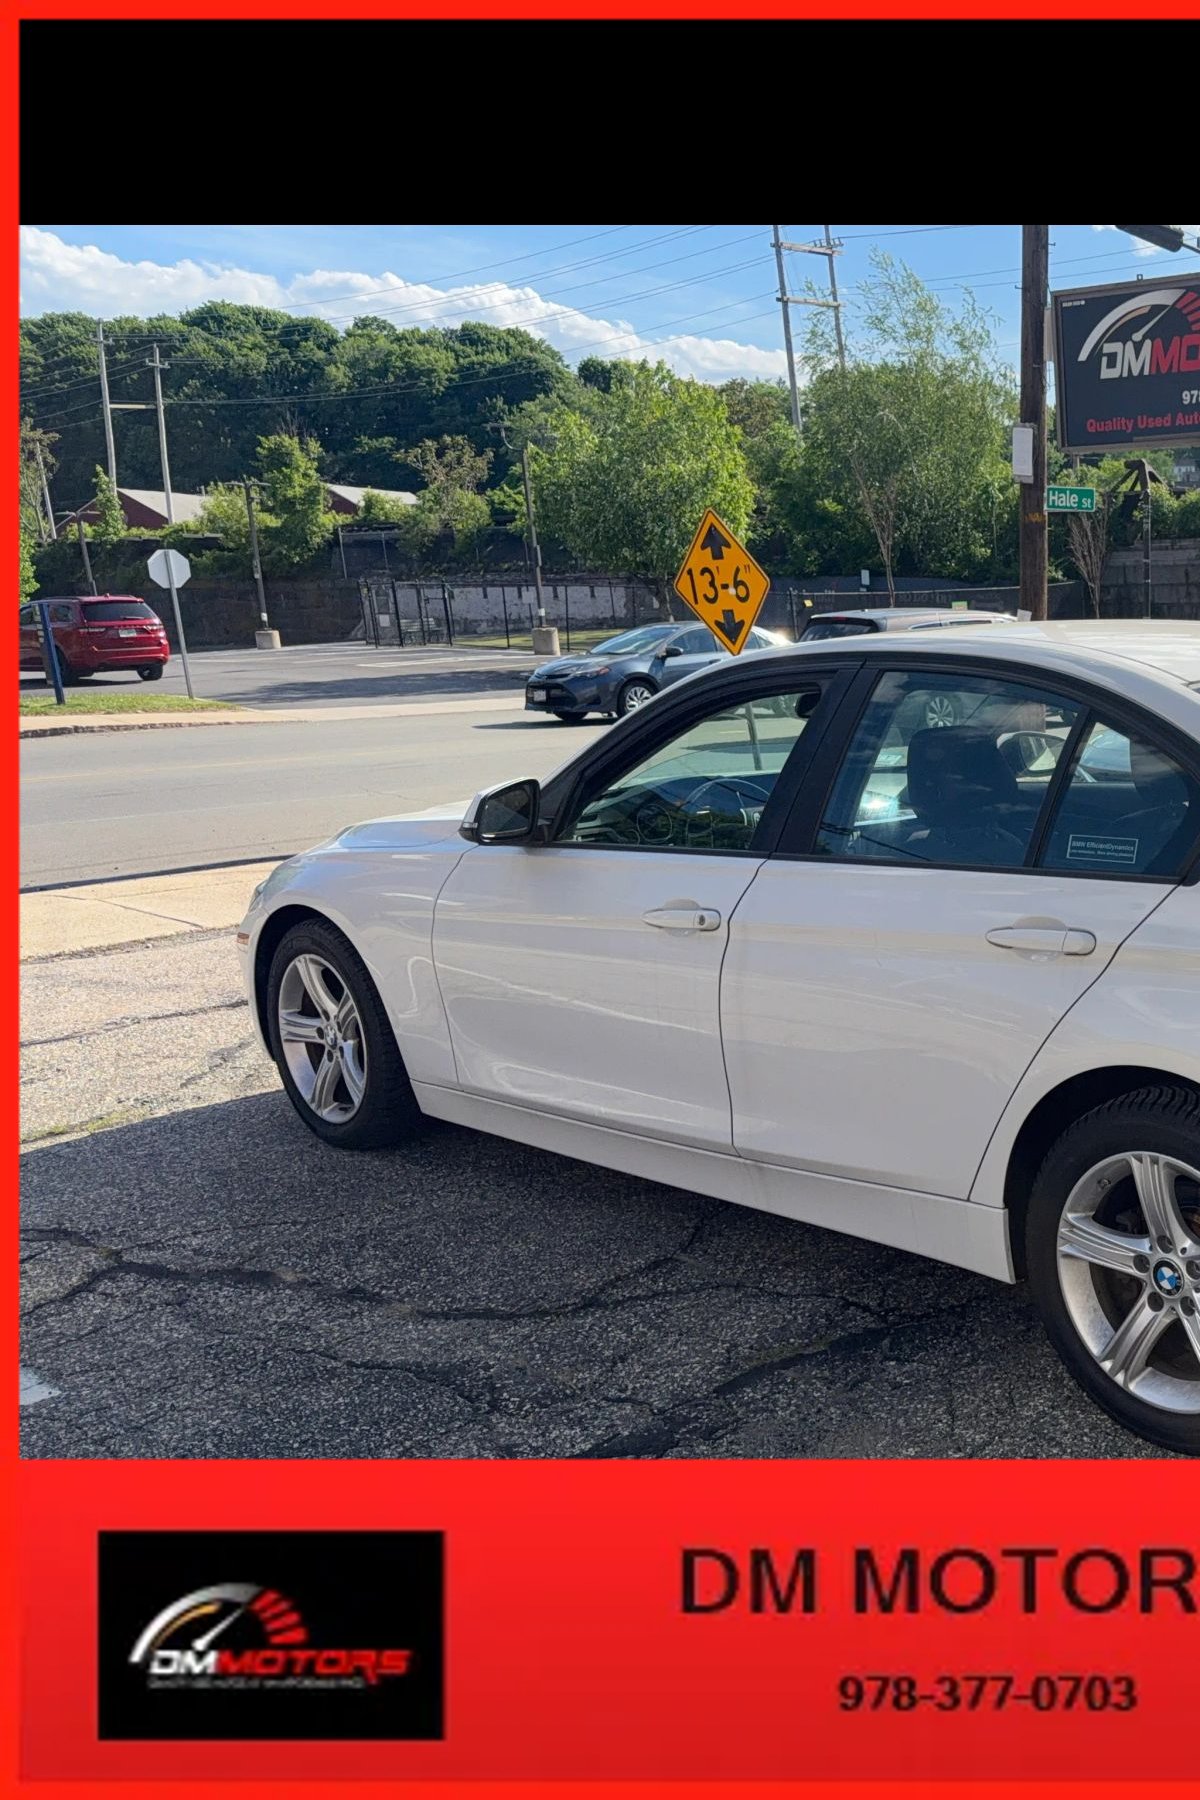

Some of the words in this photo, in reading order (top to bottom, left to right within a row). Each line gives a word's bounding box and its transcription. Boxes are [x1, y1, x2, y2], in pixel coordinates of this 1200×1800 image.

[1086, 417, 1134, 433] Quality
[1138, 413, 1172, 429] Used
[1049, 490, 1079, 508] Hale
